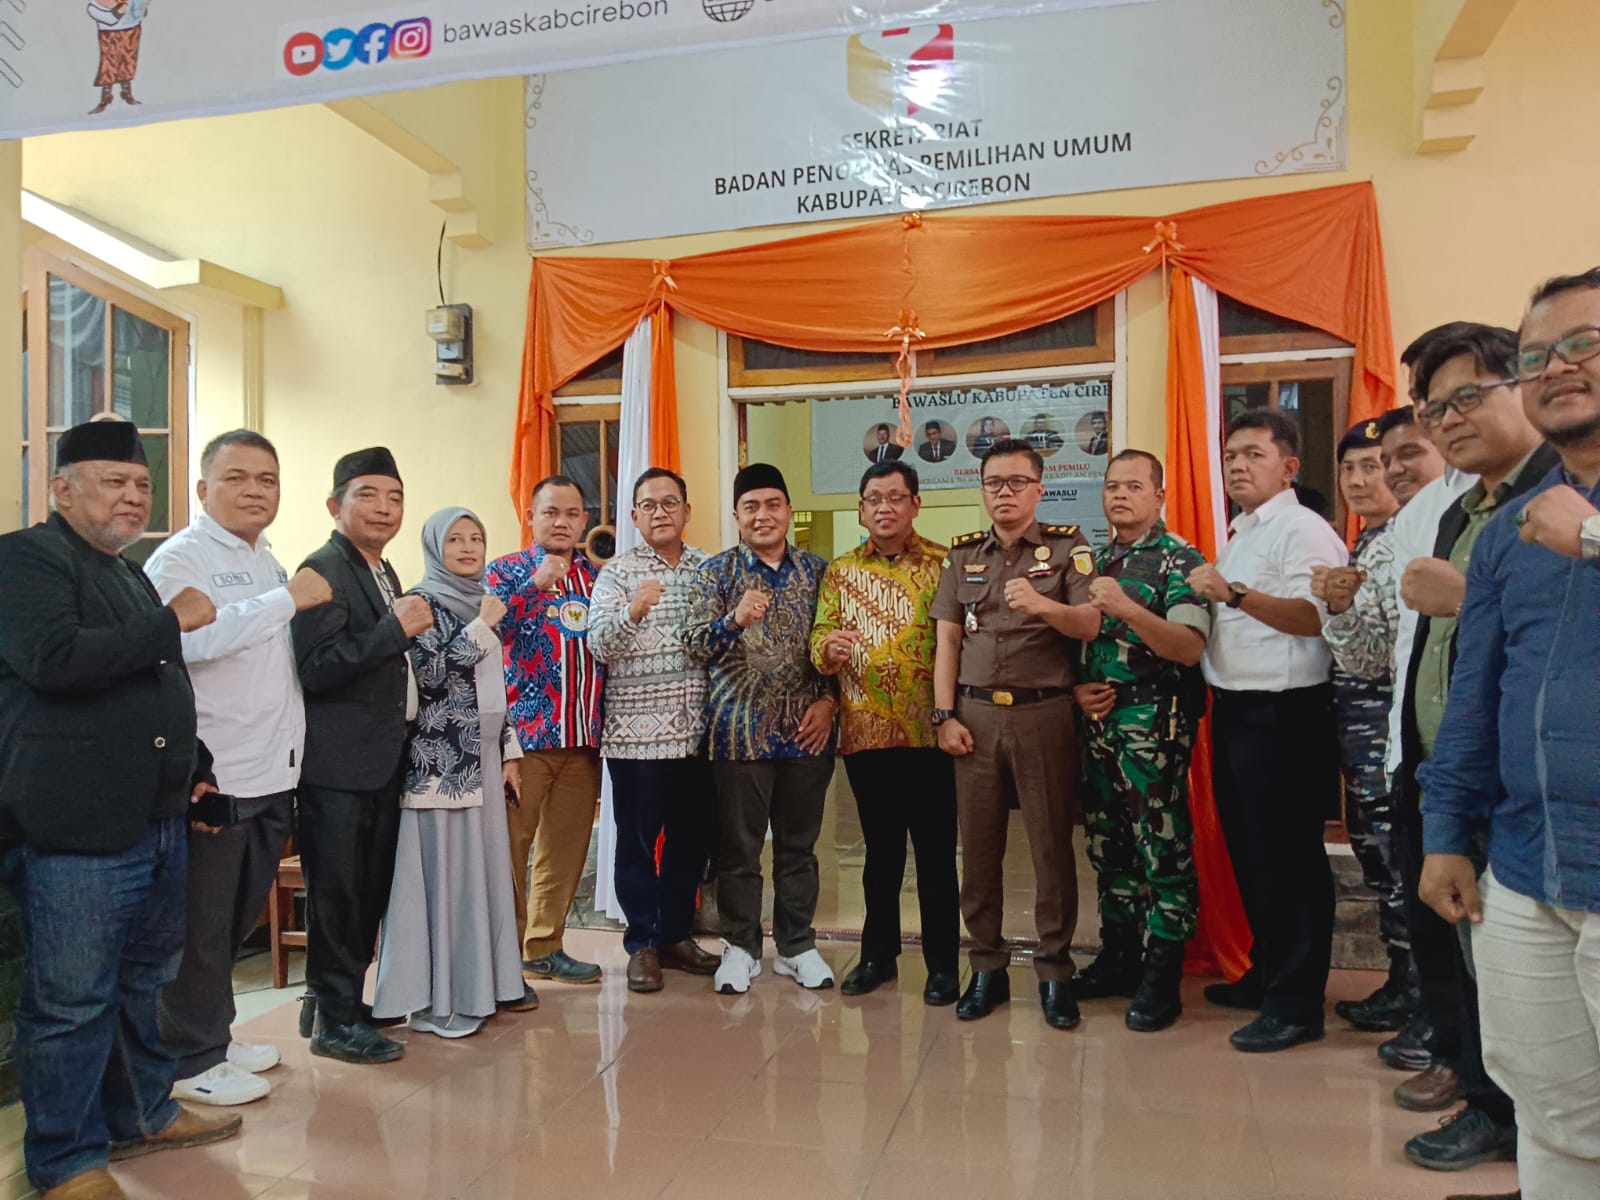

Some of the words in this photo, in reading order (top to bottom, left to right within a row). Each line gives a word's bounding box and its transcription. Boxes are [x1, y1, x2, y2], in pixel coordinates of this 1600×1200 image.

[443, 0, 668, 43] bawaskabcirebon
[841, 119, 983, 150] SEKRETRIAT
[715, 169, 785, 195] BADAN
[793, 156, 913, 186] PENGAS
[921, 141, 1045, 172] PEMILIHAN
[1054, 132, 1131, 158] UMUM
[797, 183, 927, 214] KABUPAN
[934, 172, 1030, 198] CIREBON
[972, 387, 1070, 404] KABUPTEN
[1075, 383, 1108, 398] CIR
[1042, 489, 1077, 497] AWASLU
